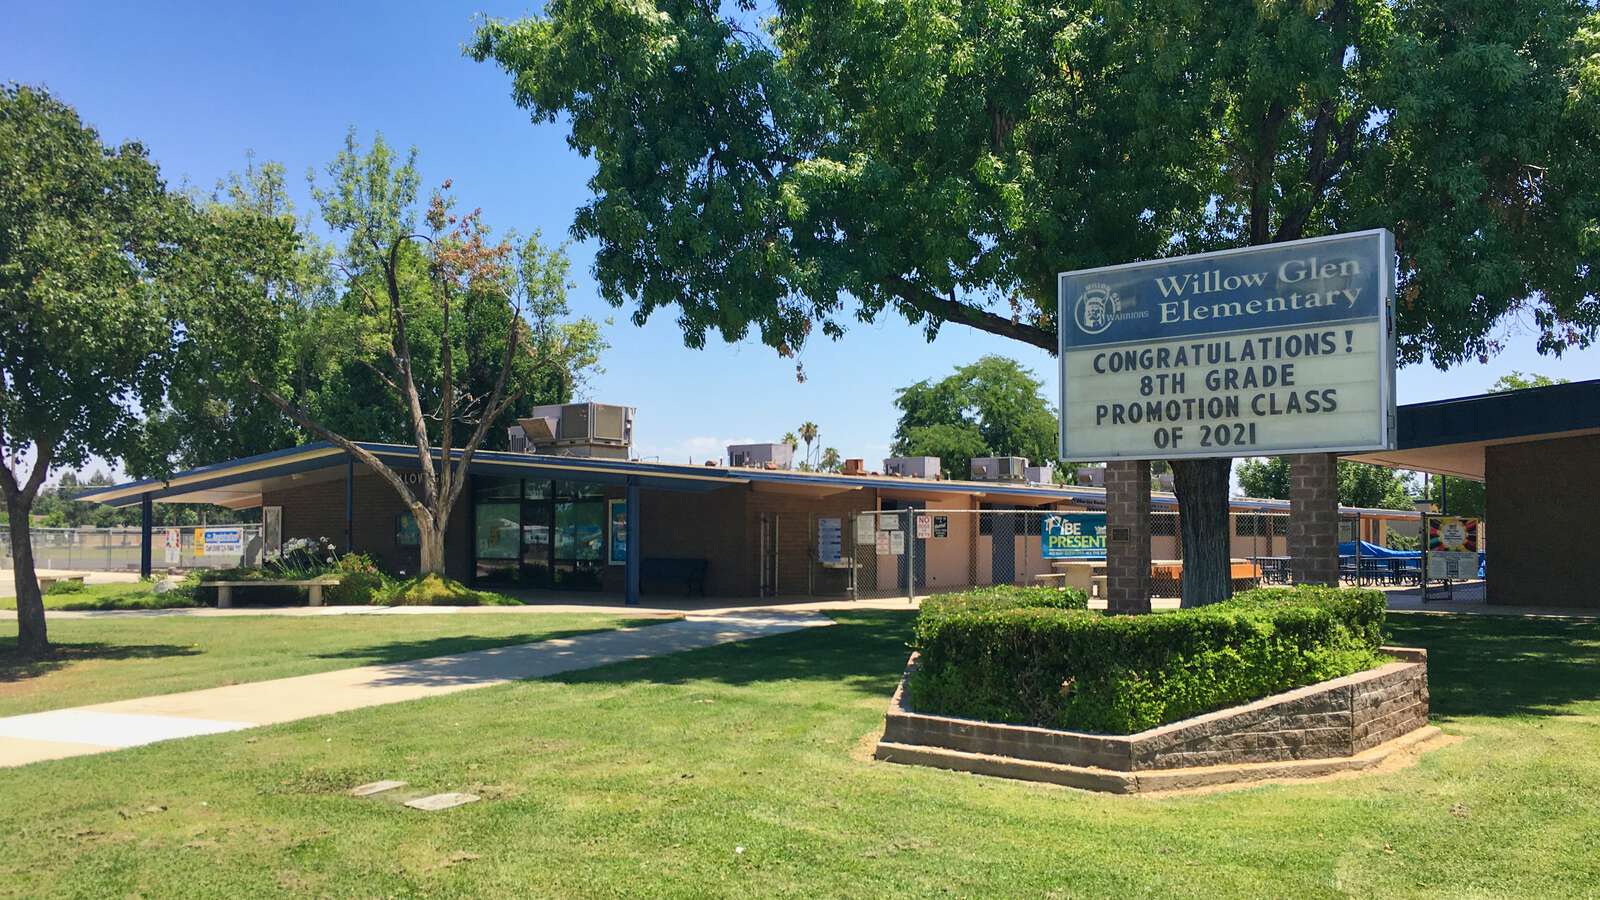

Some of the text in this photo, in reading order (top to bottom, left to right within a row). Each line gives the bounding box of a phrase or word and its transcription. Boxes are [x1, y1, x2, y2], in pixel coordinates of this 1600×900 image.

[1155, 256, 1361, 298] Willow Glen
[1159, 287, 1362, 324] Elementary
[1140, 363, 1295, 397] 8TH GRADE
[1096, 388, 1337, 426] PROMOTION CLASS
[1154, 422, 1256, 449] OF 2021
[918, 516, 931, 527] NO
[1065, 522, 1082, 536] BE
[1048, 535, 1106, 548] PRESENT
